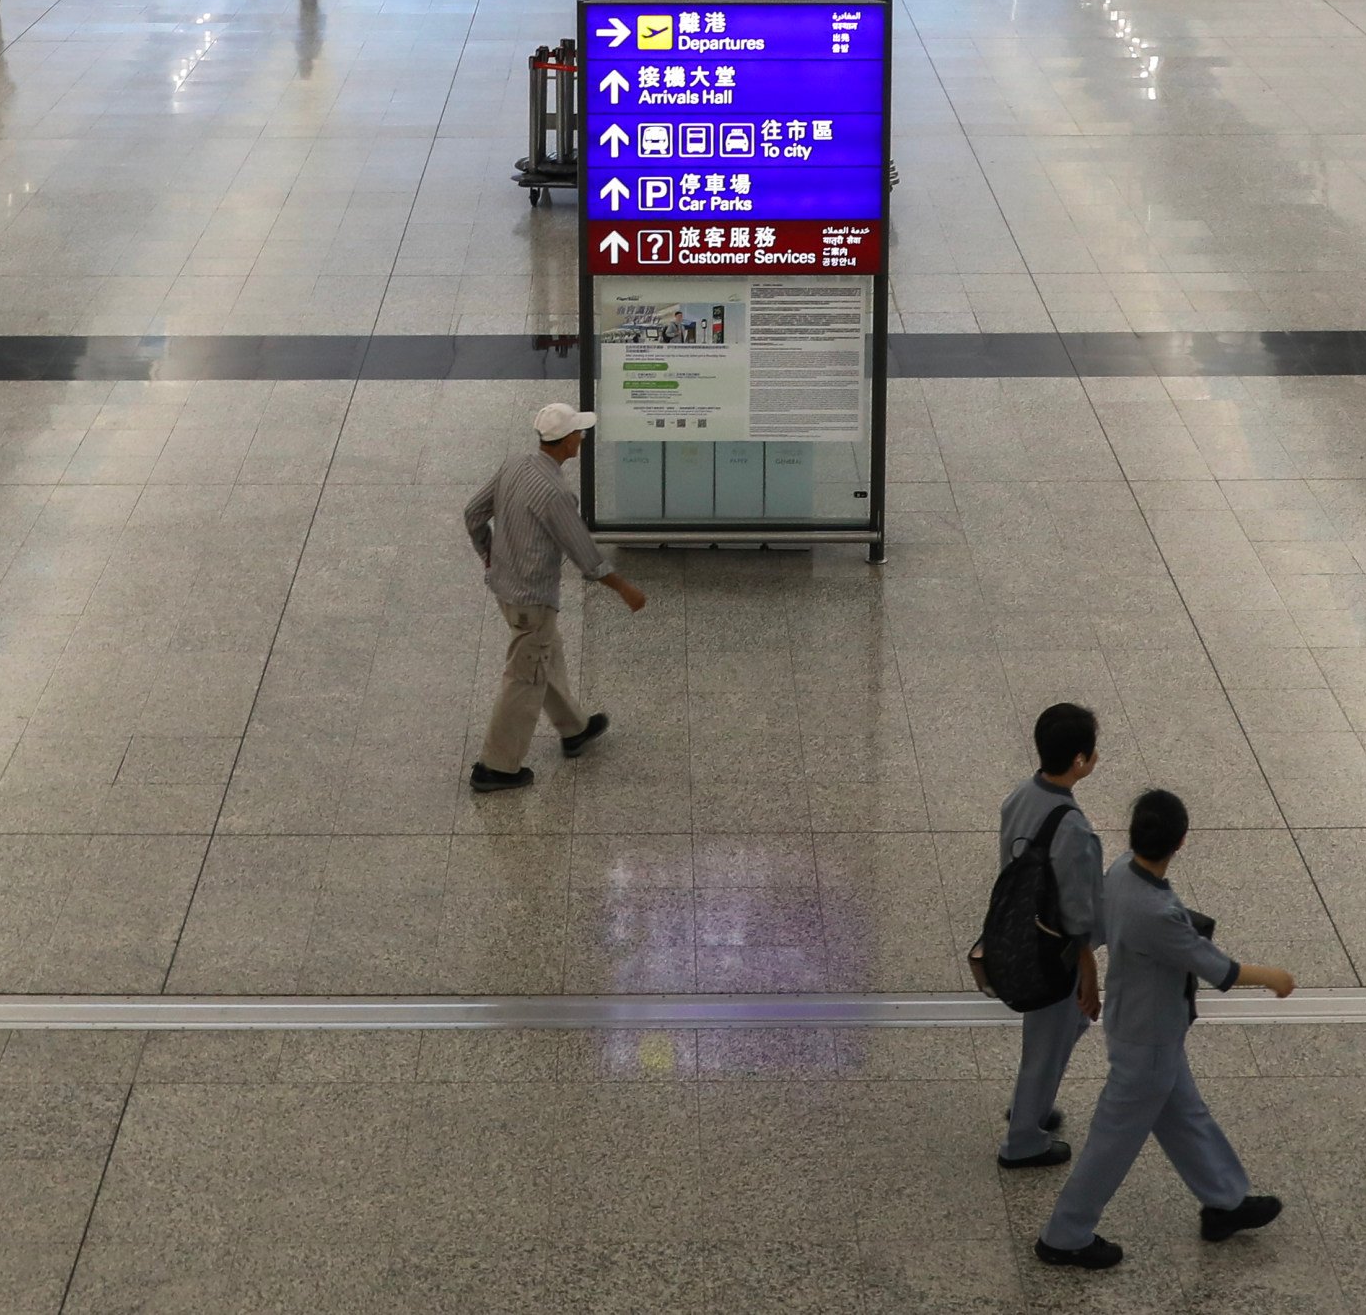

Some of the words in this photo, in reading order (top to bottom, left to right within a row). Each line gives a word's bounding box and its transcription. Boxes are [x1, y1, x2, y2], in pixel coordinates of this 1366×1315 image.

[678, 11, 727, 34] 離港
[678, 36, 765, 52] Departures
[638, 65, 736, 88] 接機大堂
[638, 89, 699, 105] Arrivals
[702, 89, 733, 105] Hall
[760, 119, 833, 141] 往市區
[761, 143, 780, 158] To
[783, 143, 813, 161] city
[646, 182, 667, 207] P
[679, 173, 752, 195] 停車場
[678, 196, 707, 212] Car
[710, 196, 753, 212] Parks
[678, 226, 777, 248] 旅客服務
[678, 249, 751, 265] Customer
[754, 249, 816, 265] Services
